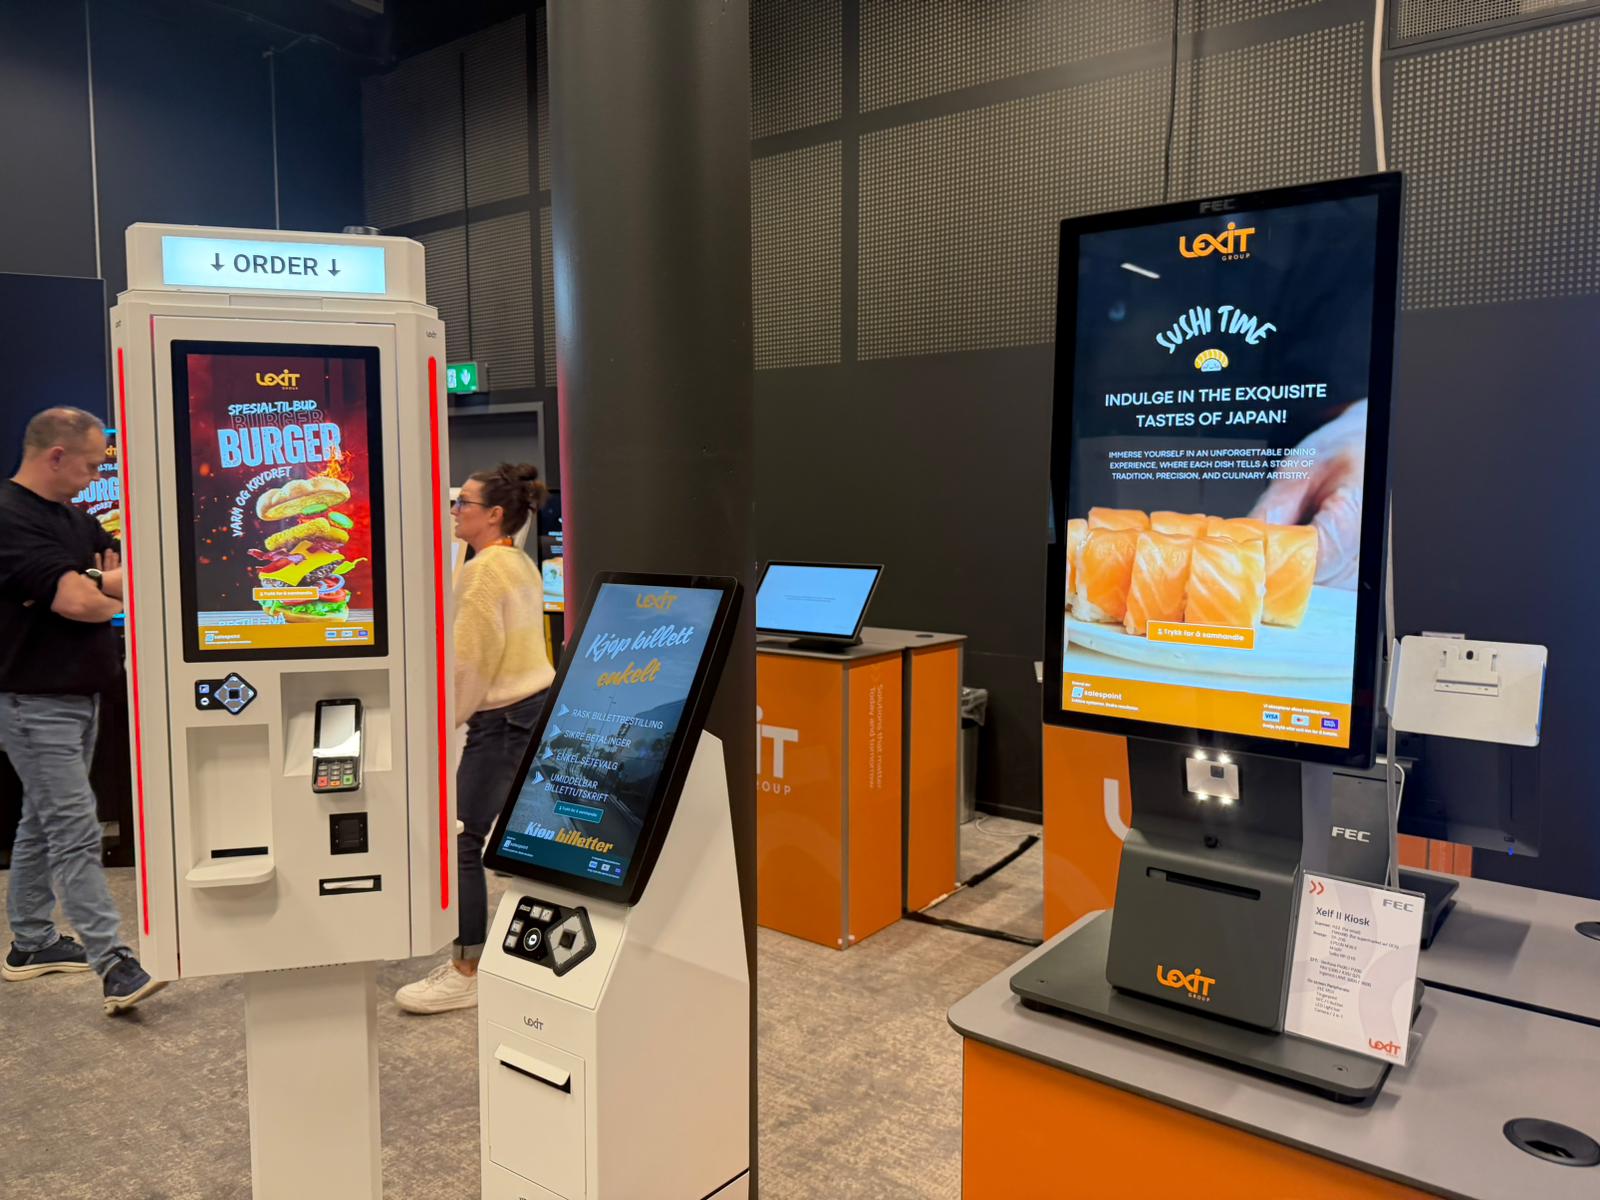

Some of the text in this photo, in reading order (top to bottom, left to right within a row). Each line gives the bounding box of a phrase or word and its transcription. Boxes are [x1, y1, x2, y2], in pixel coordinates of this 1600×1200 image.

[1200, 199, 1236, 213] FEC
[233, 253, 319, 276] ORDER
[1221, 252, 1251, 261] GROUP
[1155, 305, 1277, 354] SUSHI TIME
[1105, 383, 1327, 407] INDULGE IN THE EXQUISITE
[1136, 409, 1287, 428] TASTES OF JAPAN!
[217, 422, 343, 469] BURGER
[1108, 447, 1317, 459] IMMERSE YOURSELF IN AN UNFORGETTABLE DINING
[1159, 460, 1189, 469] WHERE
[1189, 460, 1213, 468] EACH
[1214, 459, 1234, 468] DISH
[1236, 459, 1261, 468] TELLS
[1262, 459, 1269, 468] A
[1270, 459, 1299, 468] STORY
[1300, 459, 1315, 468] OF
[1202, 471, 1221, 480] AND
[1221, 471, 1265, 479] CULINARY
[230, 466, 293, 537] VARM OG KRYDRET
[630, 624, 695, 651] billett
[597, 658, 661, 688] enkelt
[572, 708, 664, 730] RASK BILLETTBESTILLING
[563, 729, 632, 749] SIKRE BETALINGER
[556, 752, 619, 771] ENKEL SETEVALG
[550, 772, 599, 789] UMIDDELBAR
[544, 782, 610, 802] BILLETTUTSKRIFT
[555, 827, 615, 853] billetter
[1331, 826, 1371, 843] FEC
[1382, 898, 1415, 913] FEC
[1316, 907, 1335, 919] Xelf
[1344, 913, 1370, 927] Kiosk
[1188, 992, 1211, 1002] GROUP
